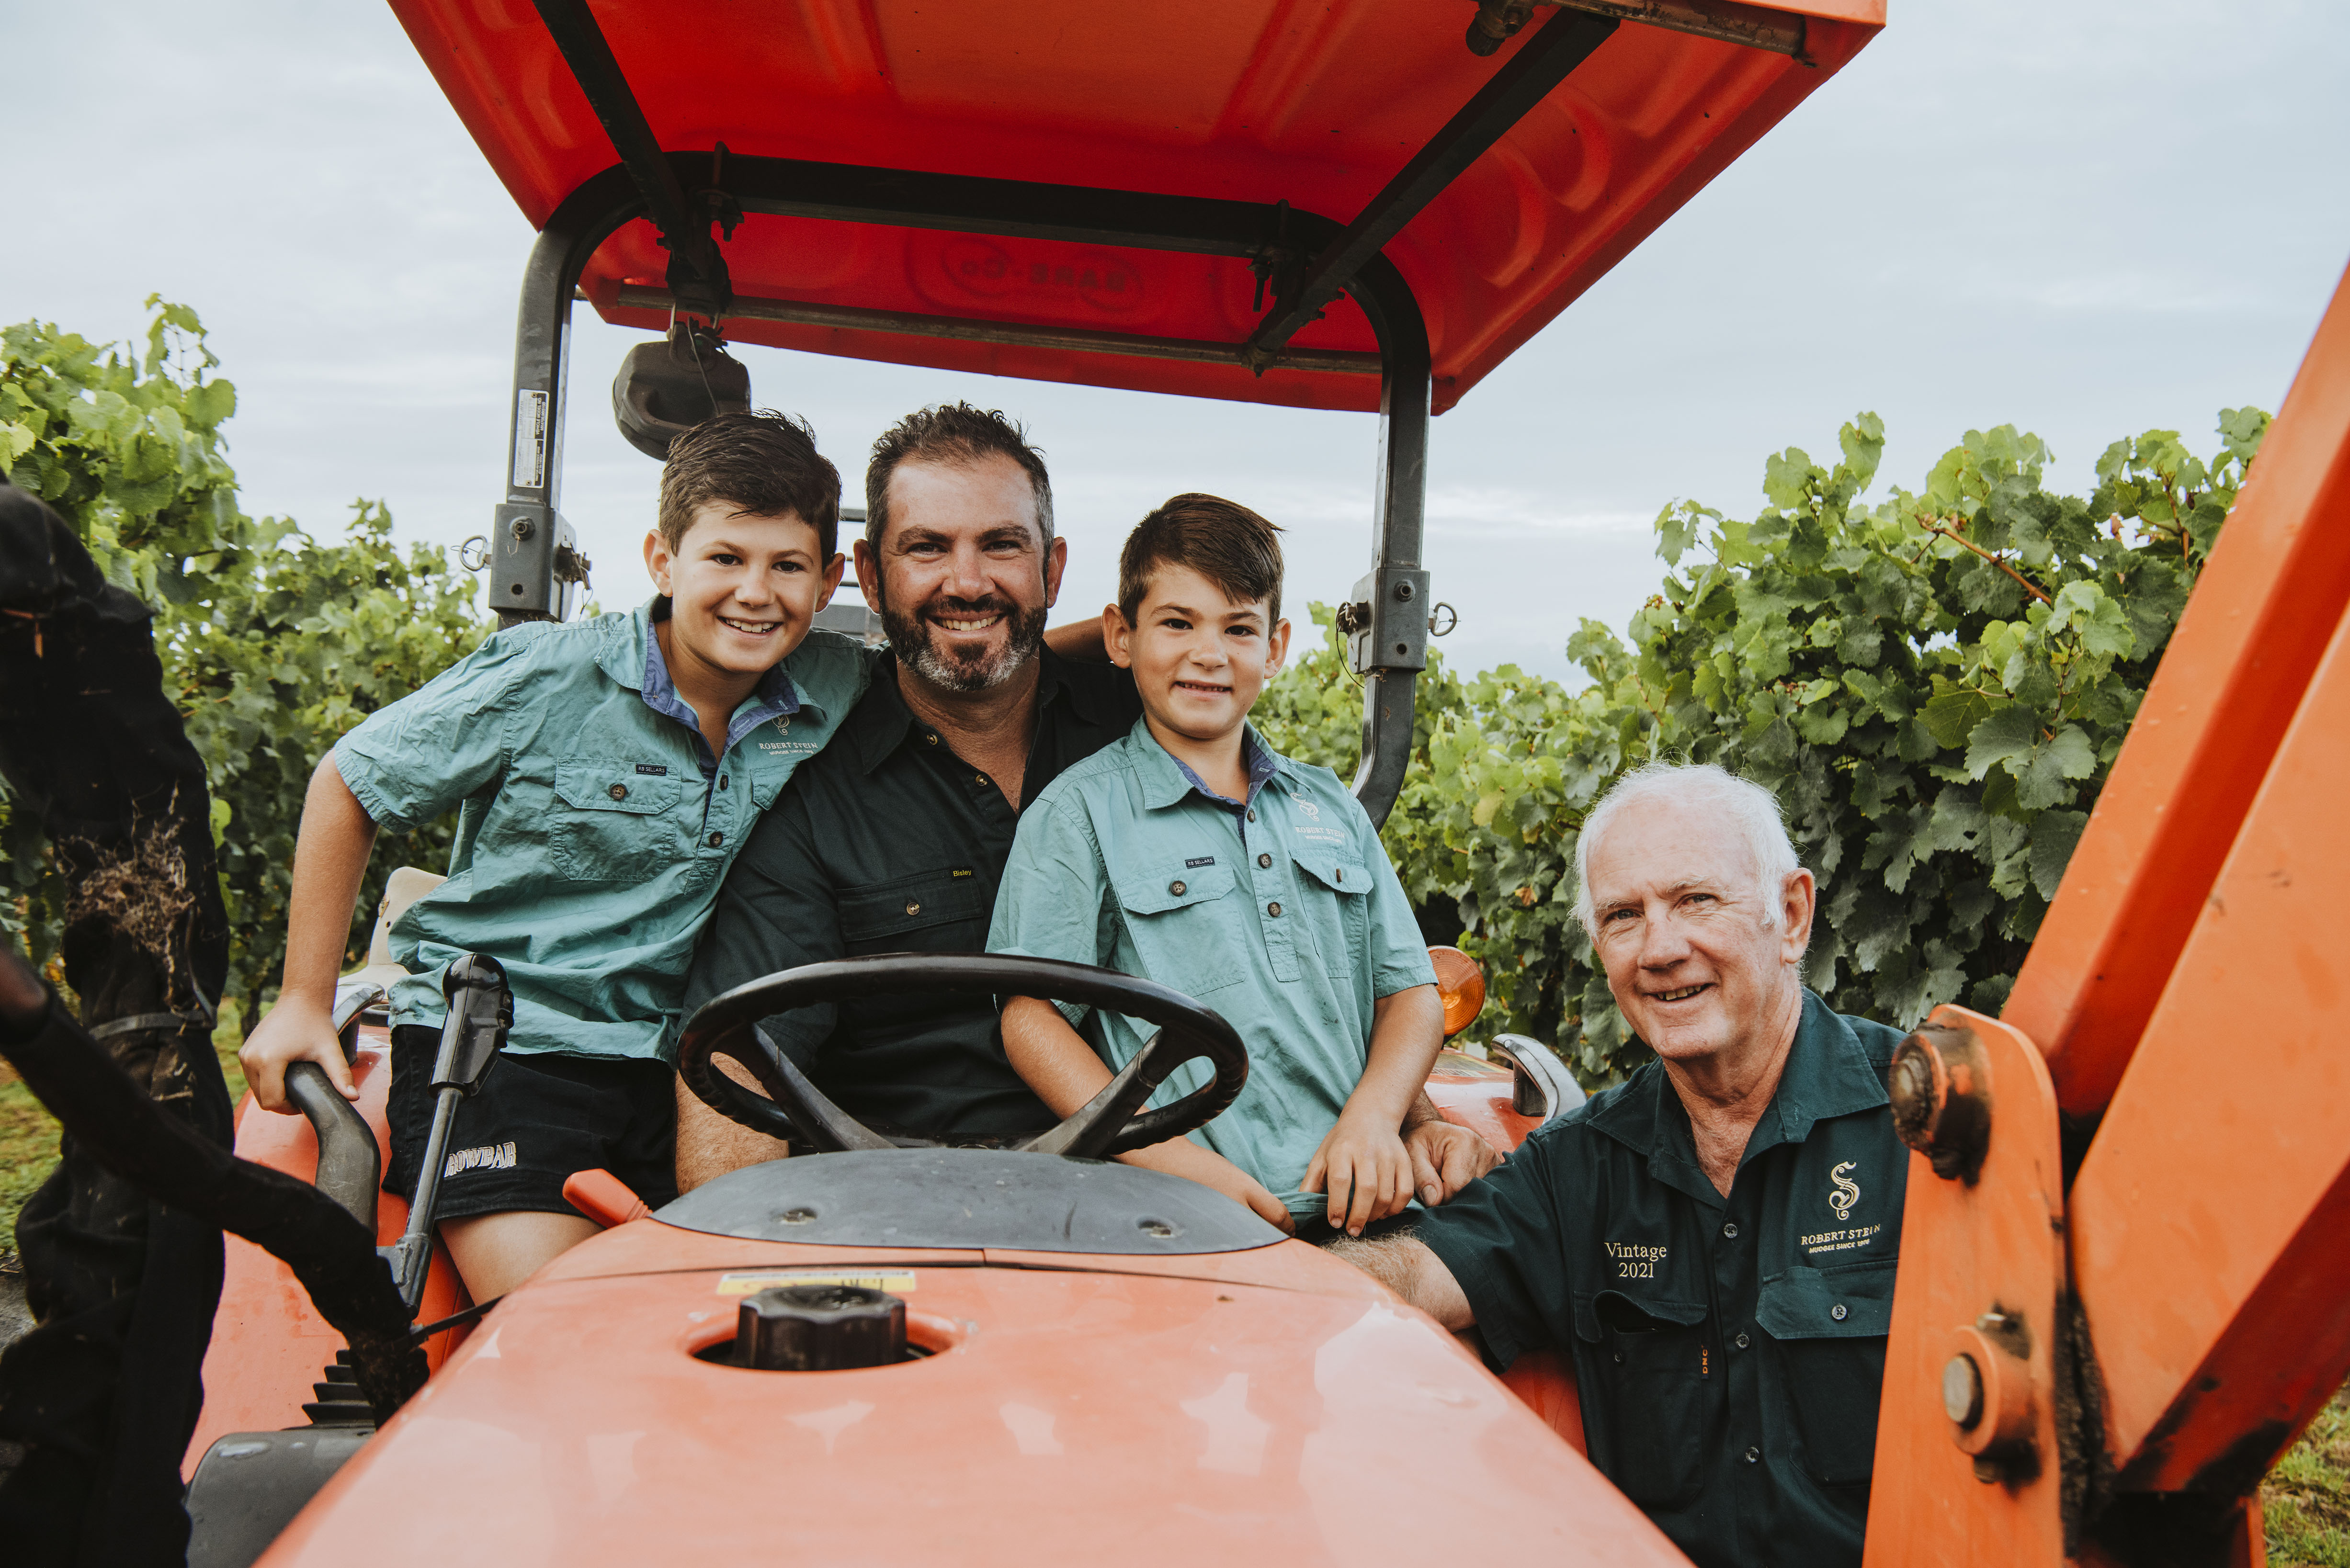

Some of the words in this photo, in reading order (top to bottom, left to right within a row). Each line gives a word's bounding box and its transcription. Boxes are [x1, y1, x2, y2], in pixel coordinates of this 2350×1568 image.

[1326, 828, 1345, 839] STEIN
[443, 1141, 517, 1178] ROWBAR
[1801, 1230, 1846, 1246] ROBERT
[1848, 1224, 1881, 1240] STEIN
[1604, 1242, 1667, 1262] Vintage
[1808, 1244, 1835, 1254] MUDGEE
[1836, 1241, 1855, 1250] SINCE
[1618, 1262, 1654, 1278] 2021
